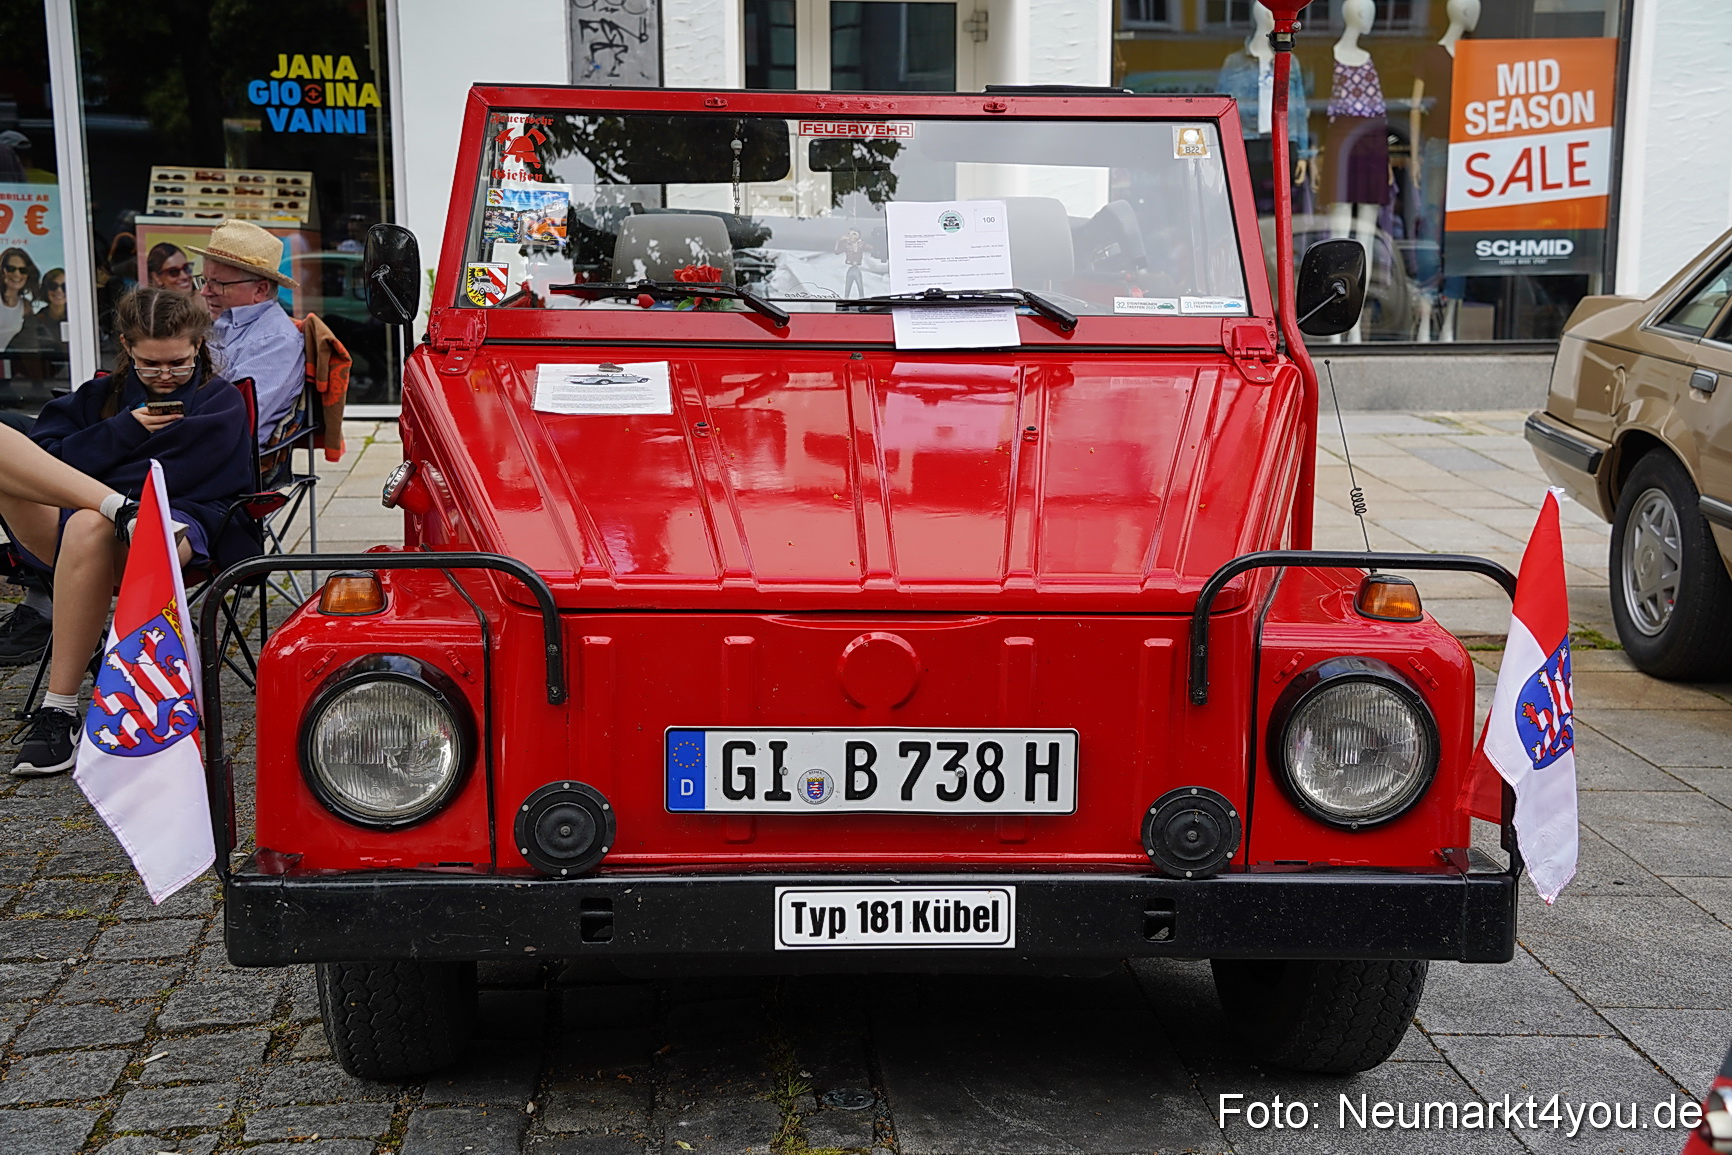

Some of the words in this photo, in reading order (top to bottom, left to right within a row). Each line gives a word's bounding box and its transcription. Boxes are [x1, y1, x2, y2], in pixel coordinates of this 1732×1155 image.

[270, 53, 359, 80] JANA
[1497, 58, 1561, 97] MID
[248, 79, 301, 106] GIO
[325, 81, 382, 107] INA
[265, 107, 366, 134] VANNI
[490, 112, 554, 126] Feuerwehr
[1464, 89, 1595, 136] SEASON
[803, 123, 910, 136] FEUERWEHR
[491, 168, 543, 182] Gießen
[1465, 140, 1591, 198] SALE
[24, 204, 50, 236] €
[982, 216, 996, 224] 100
[1475, 239, 1574, 257] SCHMID
[722, 740, 792, 801] GI
[844, 741, 878, 801] B
[899, 741, 1005, 802] 738
[1024, 742, 1060, 802] H
[680, 779, 694, 796] D
[791, 901, 847, 939] Typ
[857, 901, 904, 933] 181
[912, 900, 1000, 933] Kübel
